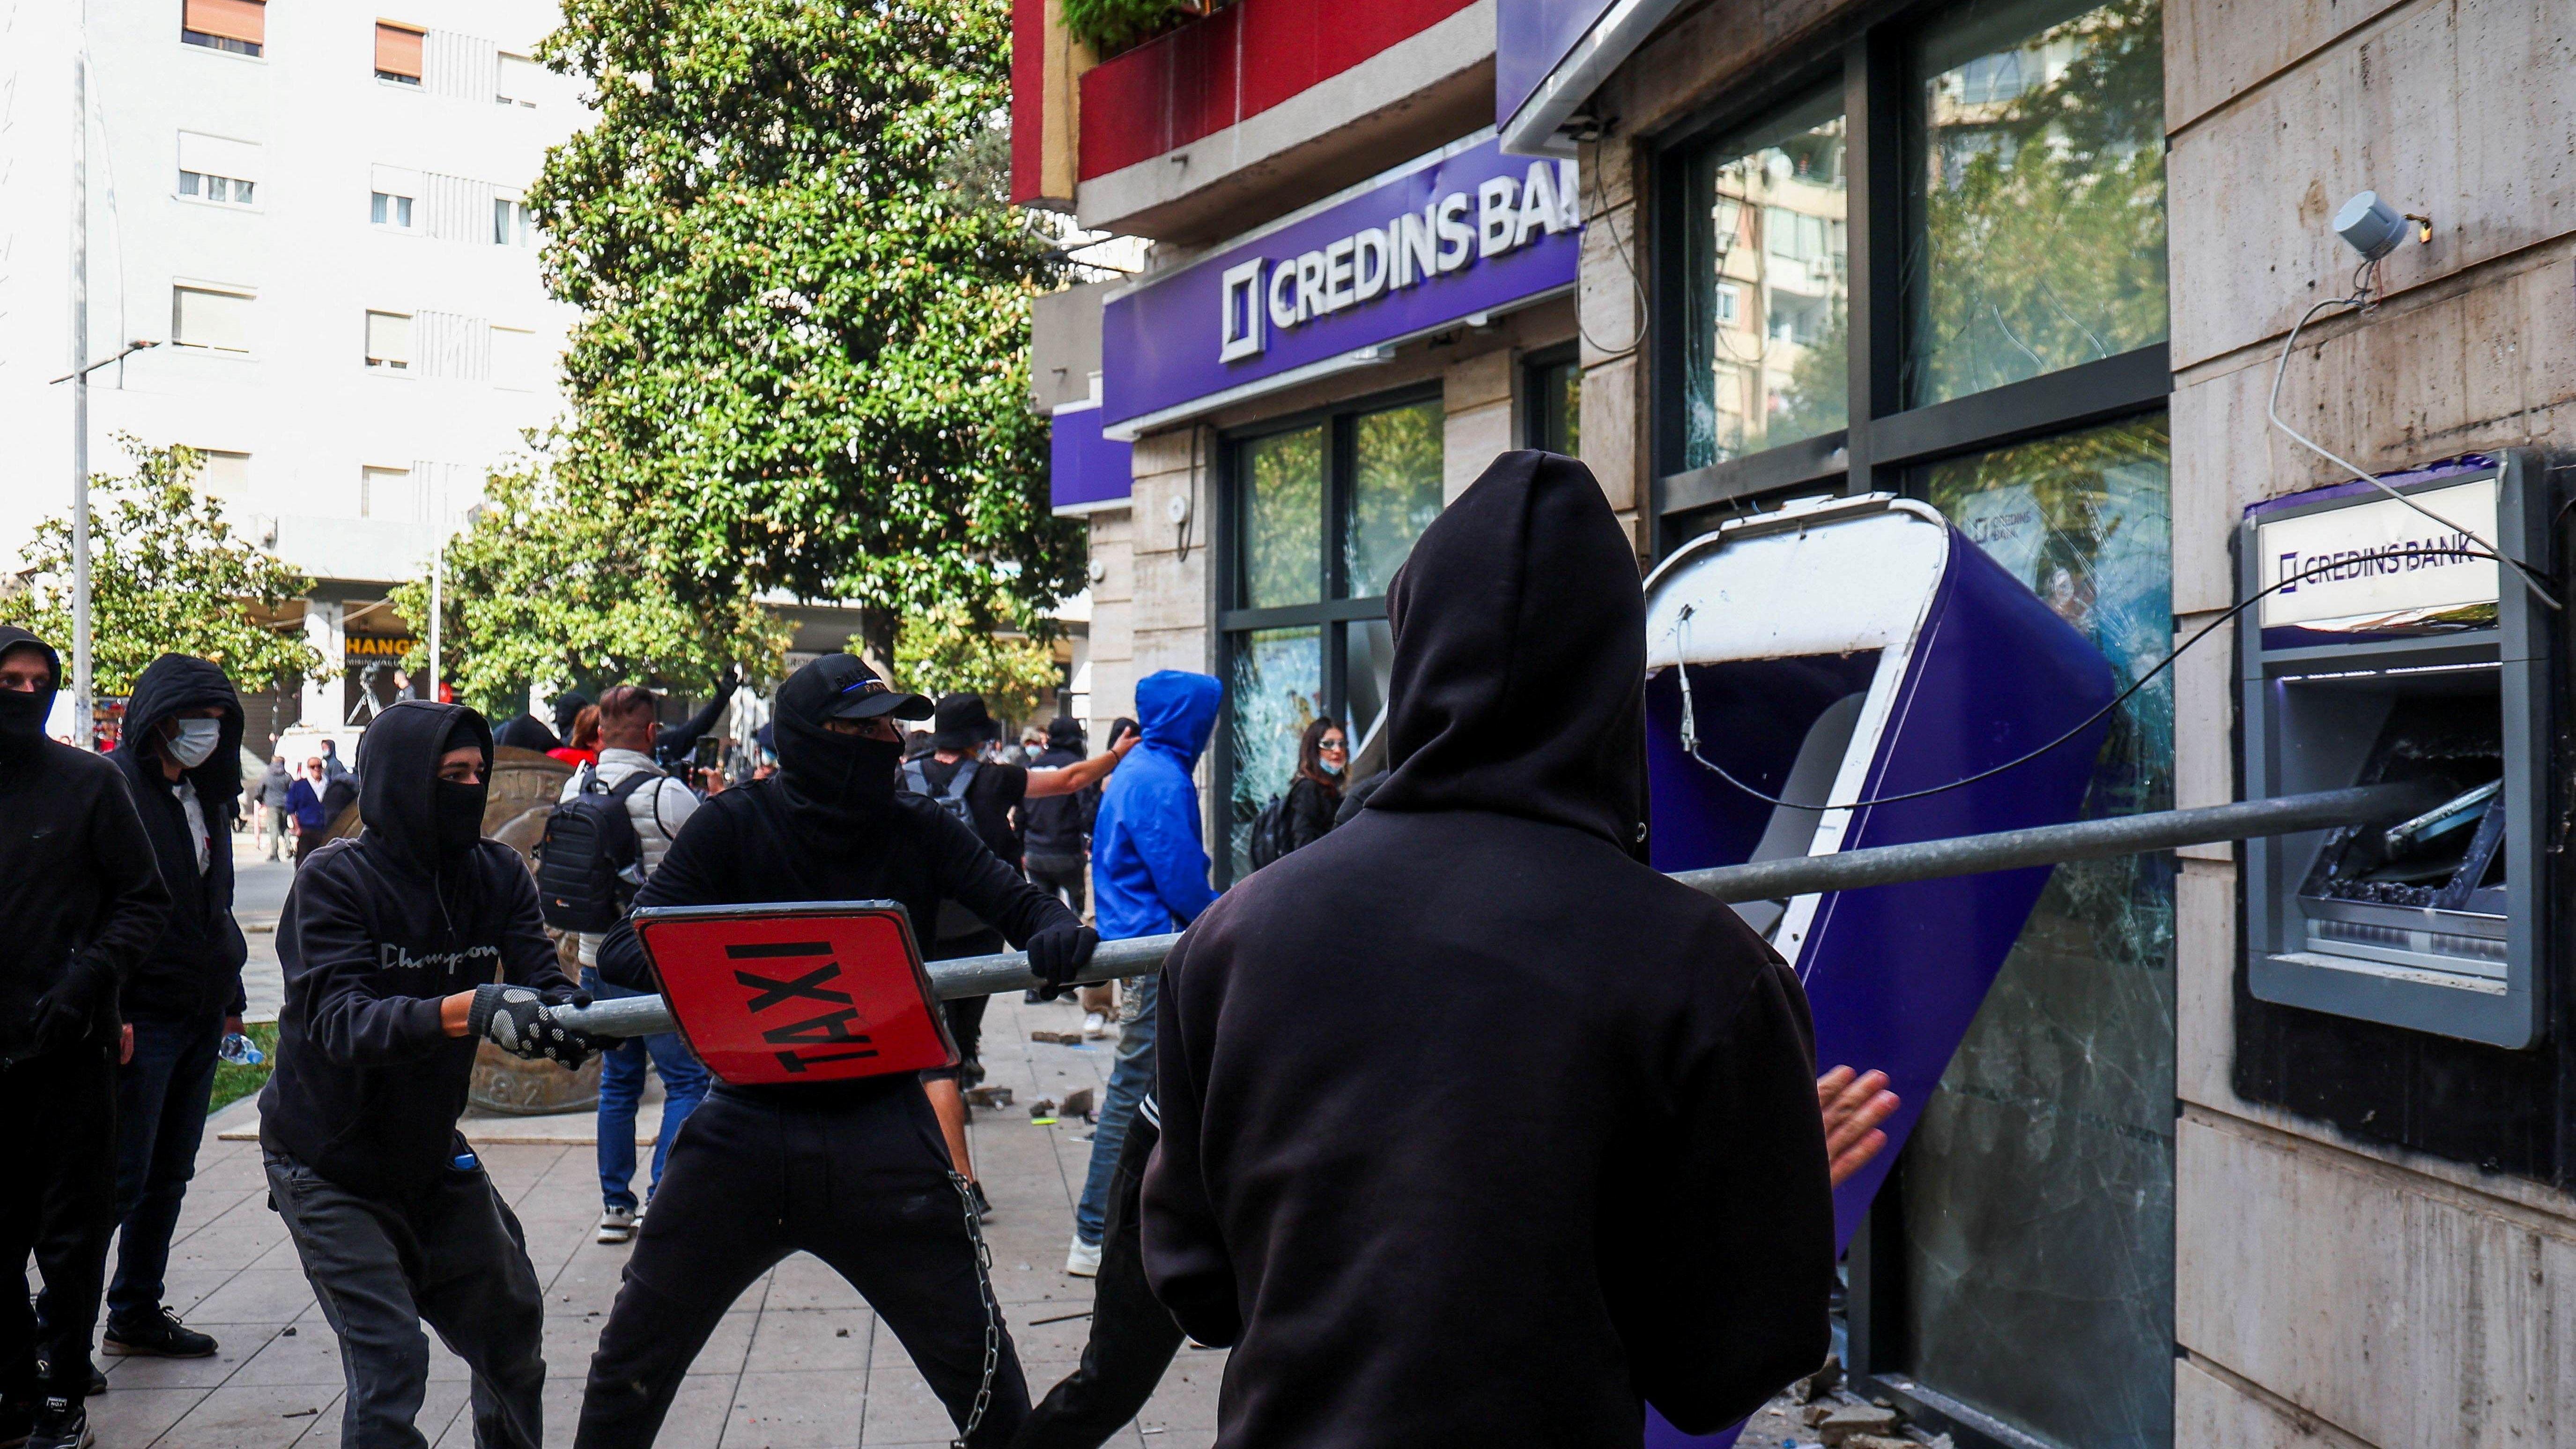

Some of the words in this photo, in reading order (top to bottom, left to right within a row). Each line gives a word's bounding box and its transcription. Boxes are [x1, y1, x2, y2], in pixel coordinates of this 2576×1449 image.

[1269, 192, 1477, 329] CREDINS
[2304, 543, 2400, 584] CREDINS
[2406, 532, 2476, 571] BANK
[725, 941, 879, 1073] TAXI
